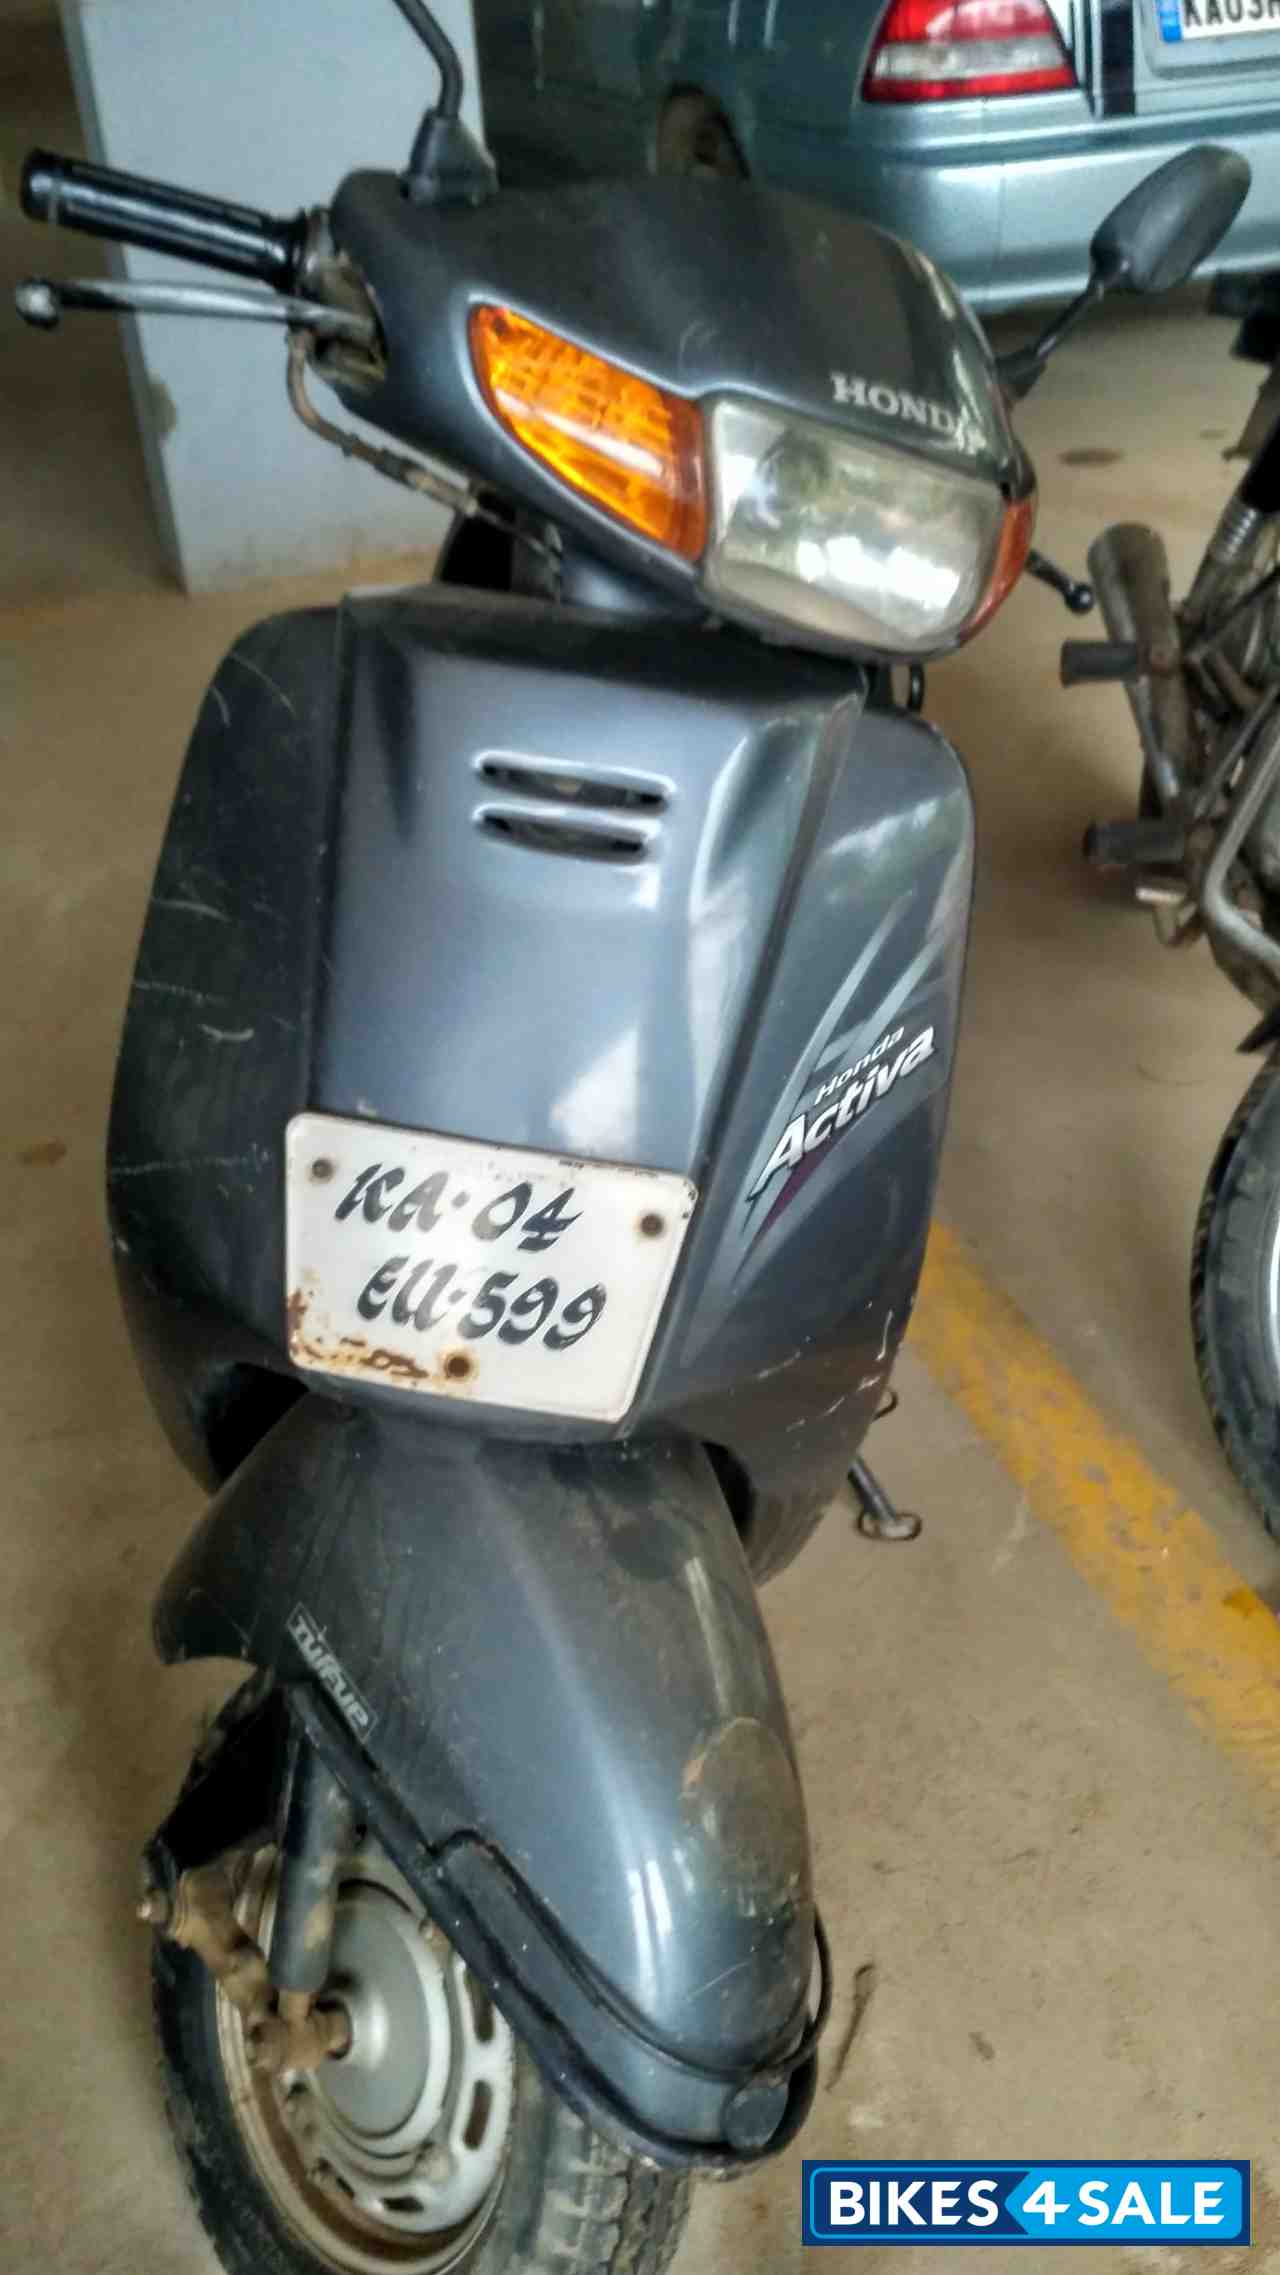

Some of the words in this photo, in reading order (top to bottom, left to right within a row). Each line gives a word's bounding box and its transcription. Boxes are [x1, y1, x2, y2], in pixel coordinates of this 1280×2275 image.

[830, 371, 986, 455] HONDA
[814, 1026, 905, 1104] Honda
[746, 1025, 935, 1202] Activa
